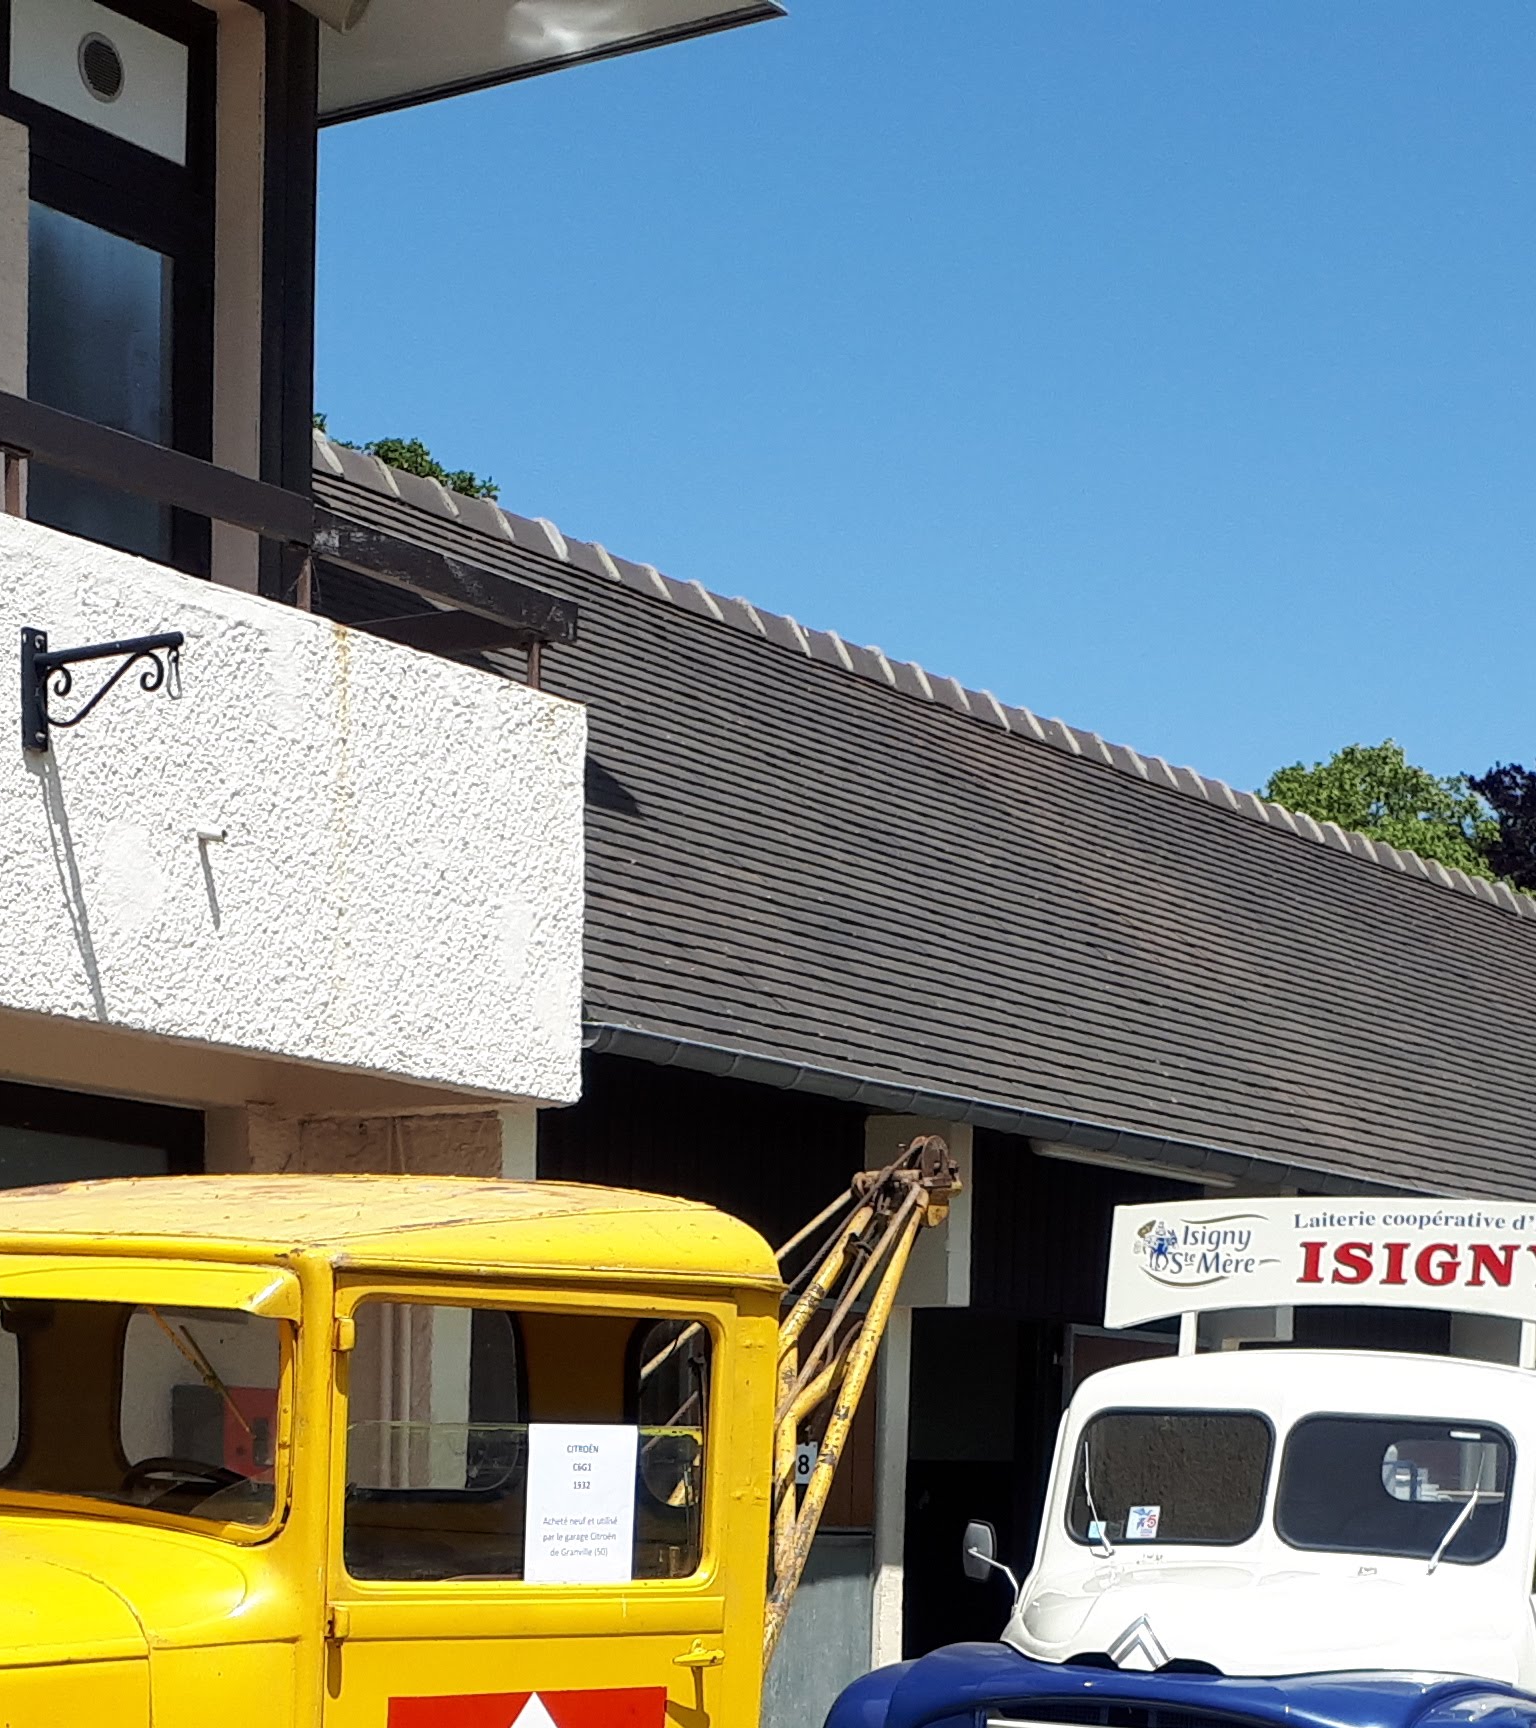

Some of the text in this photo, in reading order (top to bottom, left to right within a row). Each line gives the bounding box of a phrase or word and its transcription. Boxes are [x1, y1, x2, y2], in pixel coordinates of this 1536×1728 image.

[1293, 1212, 1376, 1229] Laiterie
[1382, 1210, 1506, 1230] coopérative
[1182, 1225, 1251, 1252] Isigny
[1196, 1252, 1256, 1274] Mère
